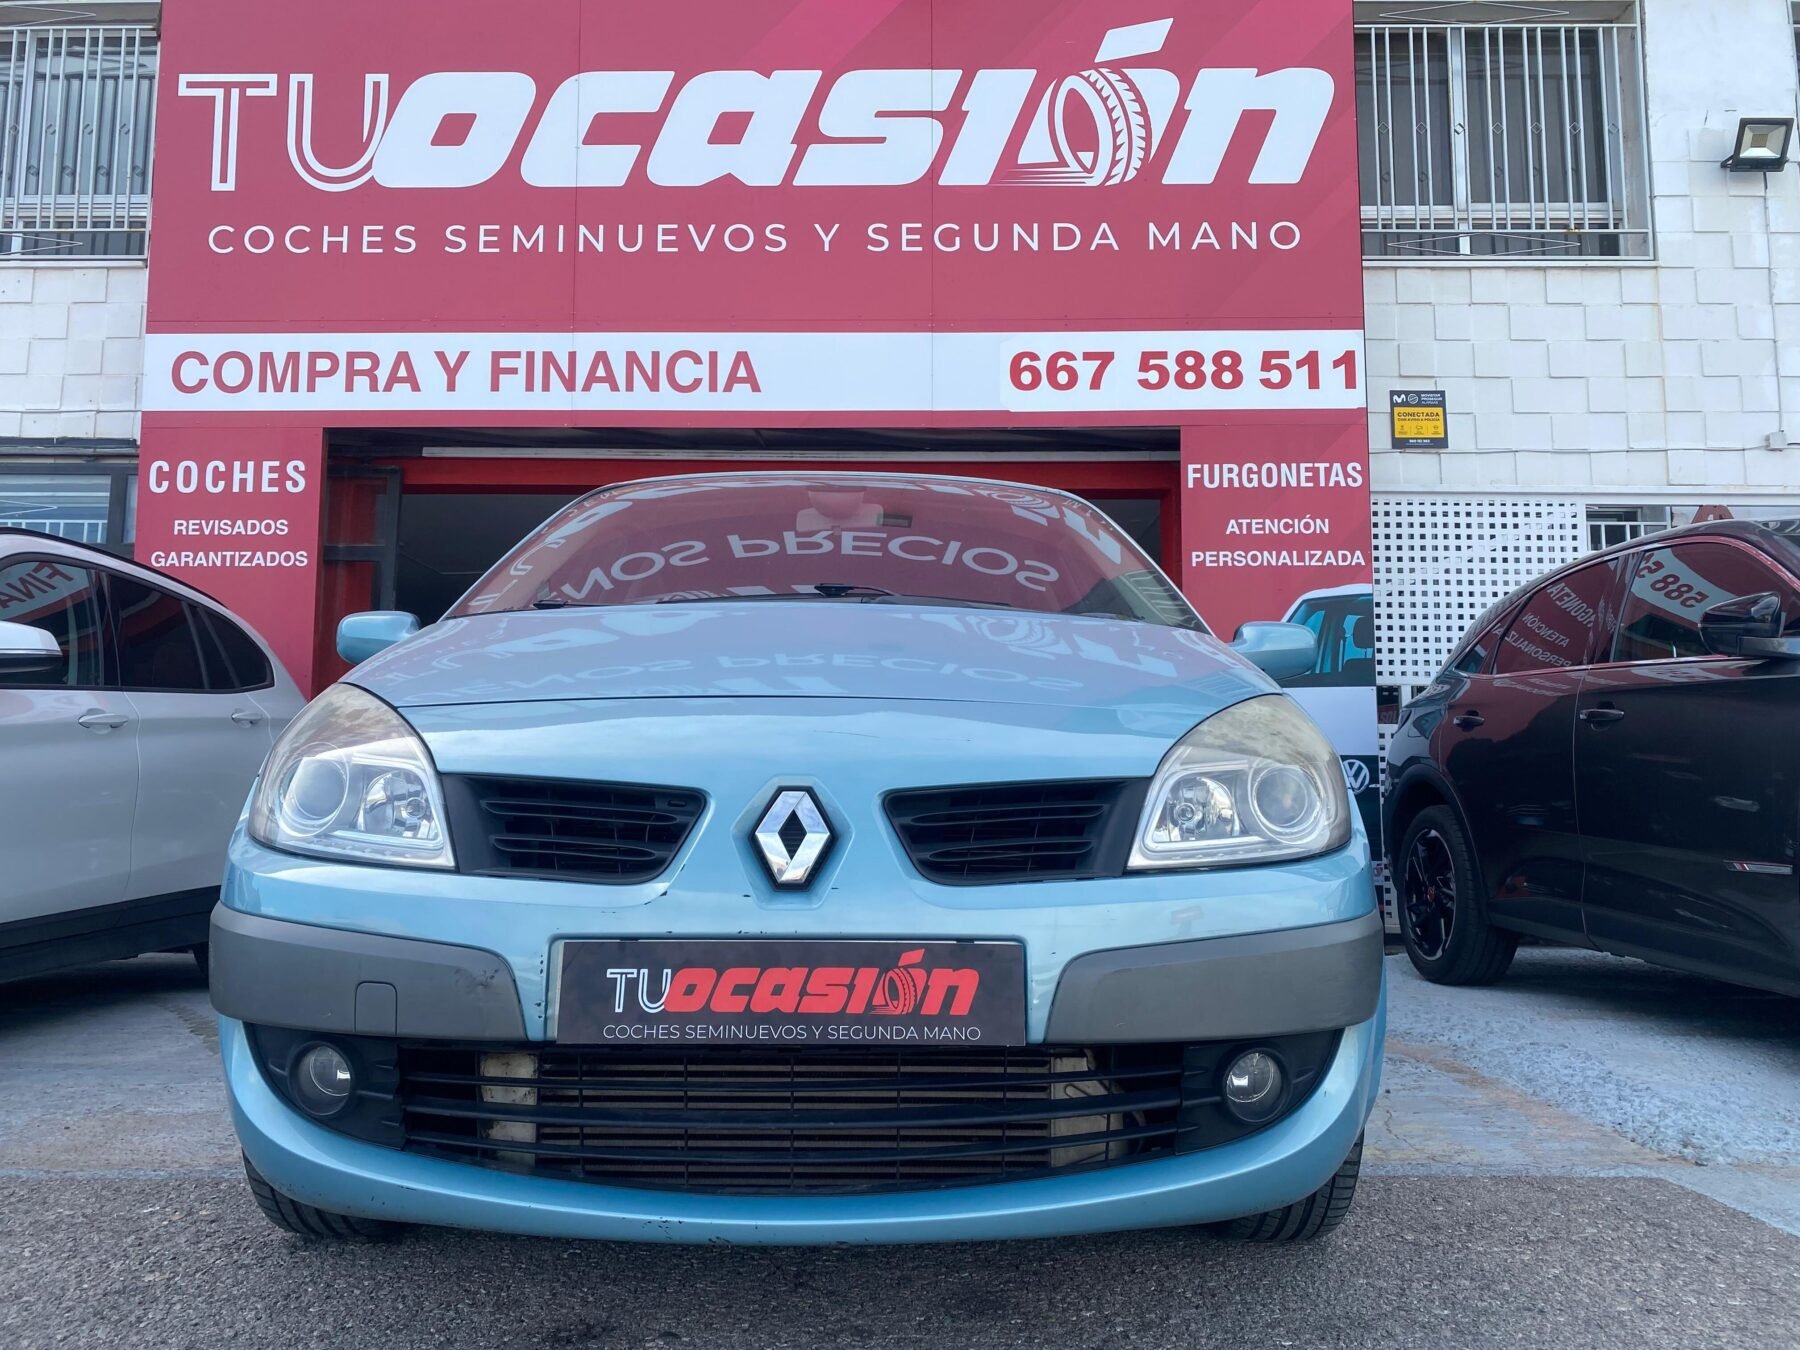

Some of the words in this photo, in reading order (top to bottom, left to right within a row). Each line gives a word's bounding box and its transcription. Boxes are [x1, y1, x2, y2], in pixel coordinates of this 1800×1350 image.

[208, 224, 417, 254] COCHES
[444, 223, 787, 254] SEMINUEVOS
[813, 223, 840, 253] Y
[867, 222, 1119, 253] SEGUNDA
[1148, 221, 1301, 251] MANO
[171, 350, 421, 394] COMPRA
[433, 350, 471, 393] Y
[490, 349, 762, 394] FINANCIA
[1009, 350, 1115, 392] 667
[1137, 349, 1244, 391] 588
[1259, 349, 1358, 390] 511
[149, 460, 306, 494] COCHES
[1187, 462, 1363, 490] FURGONETAS
[173, 519, 289, 536] REVISADOS
[1225, 513, 1330, 535] ATENCIÓN
[150, 550, 308, 567] GARANTIZADOS
[1191, 550, 1366, 567] PERSONALIZADA
[603, 1024, 680, 1039] COCHES
[685, 1024, 807, 1040] SEMINUEVOS
[812, 1025, 824, 1040] Y
[827, 1025, 919, 1041] SEGUNDA
[924, 1026, 981, 1041] MANO
